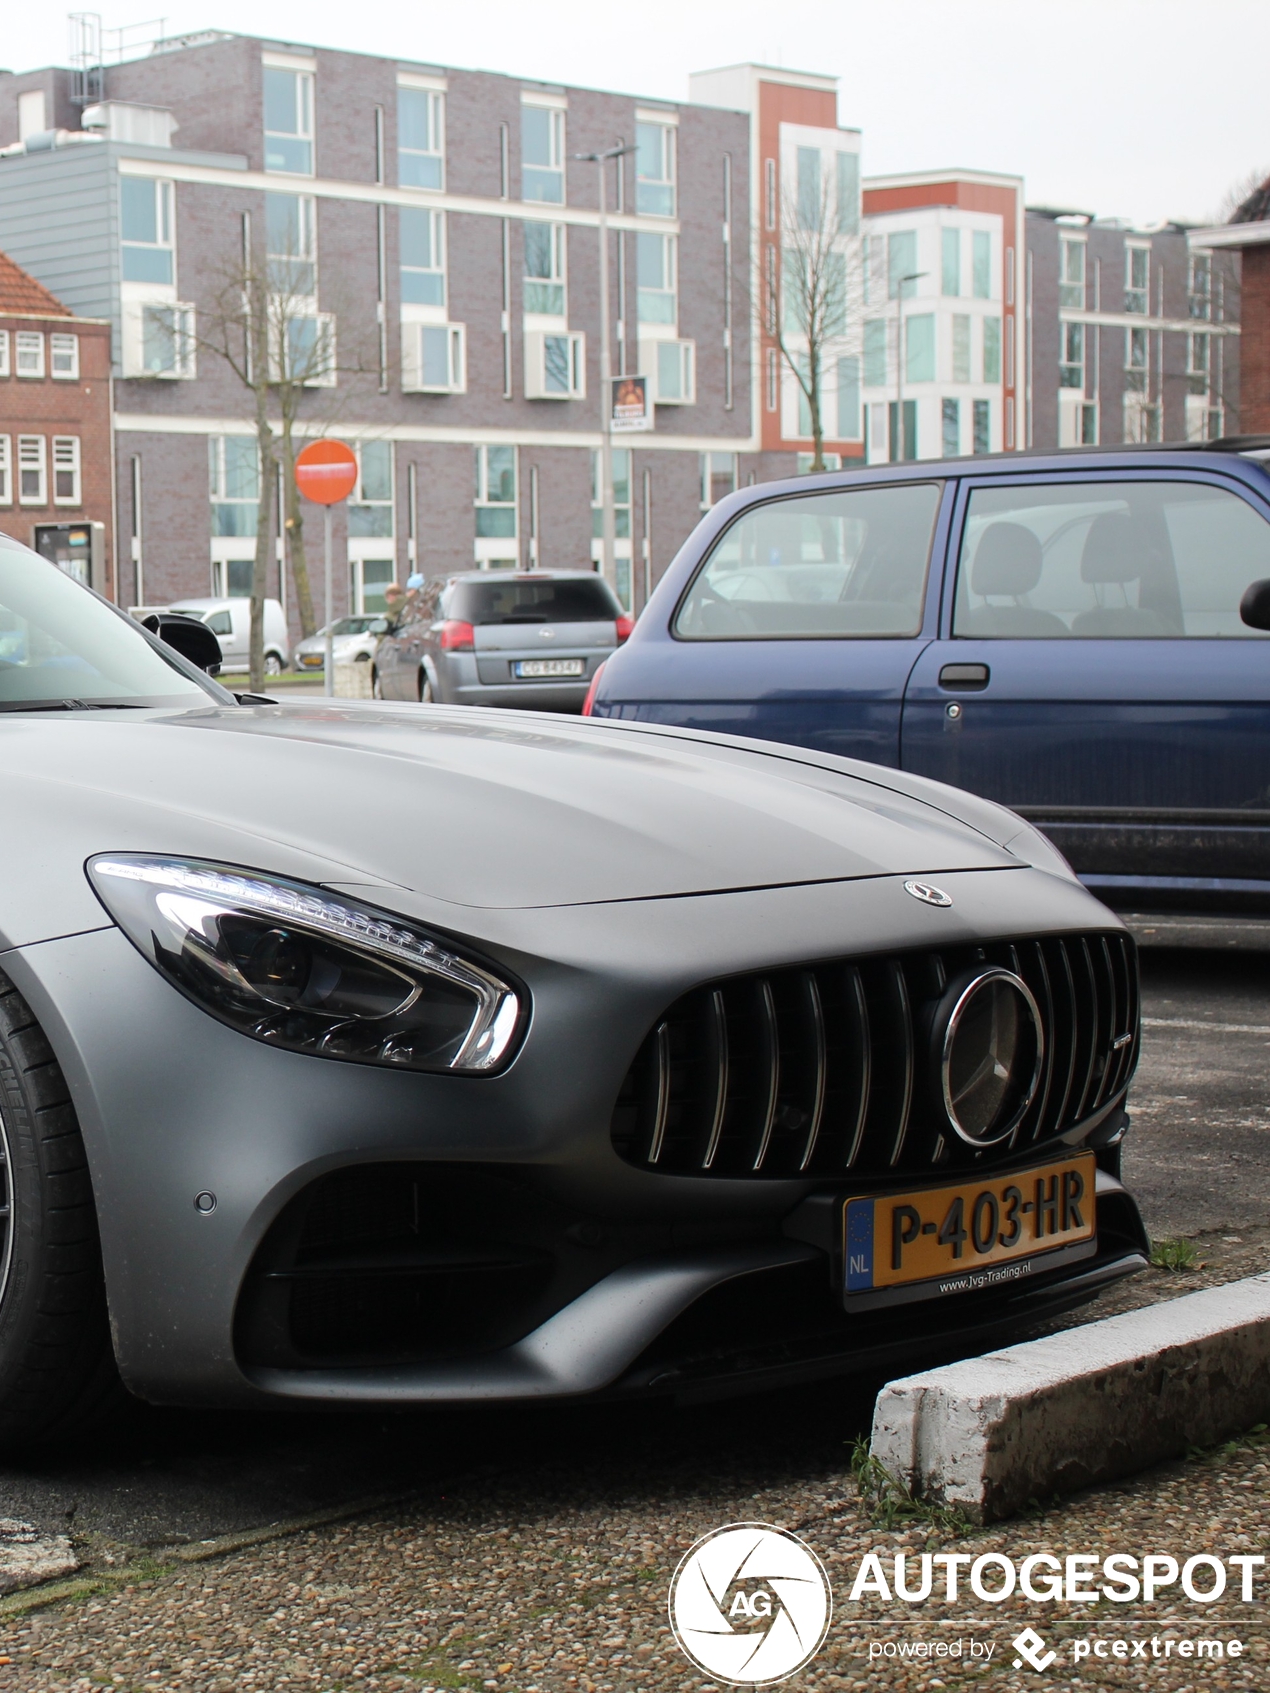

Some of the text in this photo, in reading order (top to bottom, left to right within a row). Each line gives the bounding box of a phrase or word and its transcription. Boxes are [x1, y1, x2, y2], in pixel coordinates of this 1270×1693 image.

[891, 1170, 1086, 1271] P-403-HR
[849, 1254, 869, 1275] NL
[939, 1262, 1032, 1293] www.Jvg-Trading.nl
